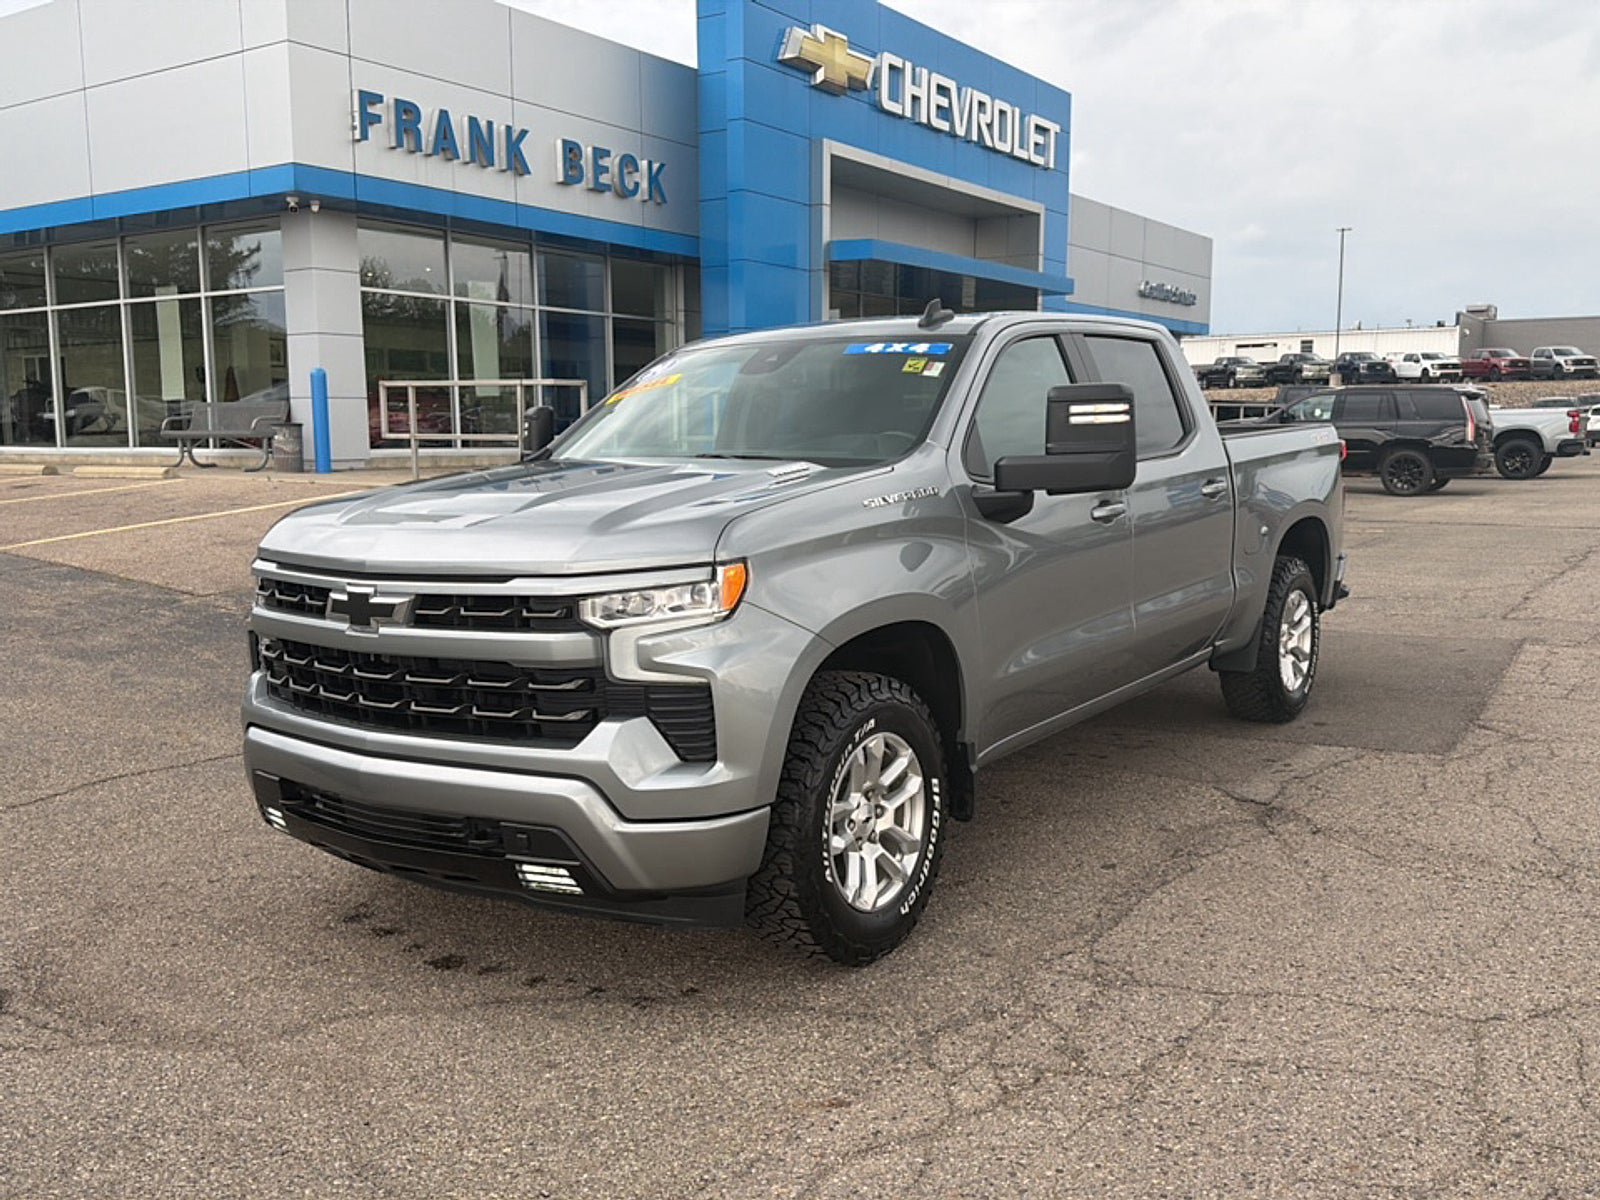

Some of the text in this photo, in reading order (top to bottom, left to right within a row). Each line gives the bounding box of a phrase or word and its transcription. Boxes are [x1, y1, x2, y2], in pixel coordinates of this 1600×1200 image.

[353, 89, 668, 204] FRANK BECK
[878, 52, 1060, 169] CHEVROLET
